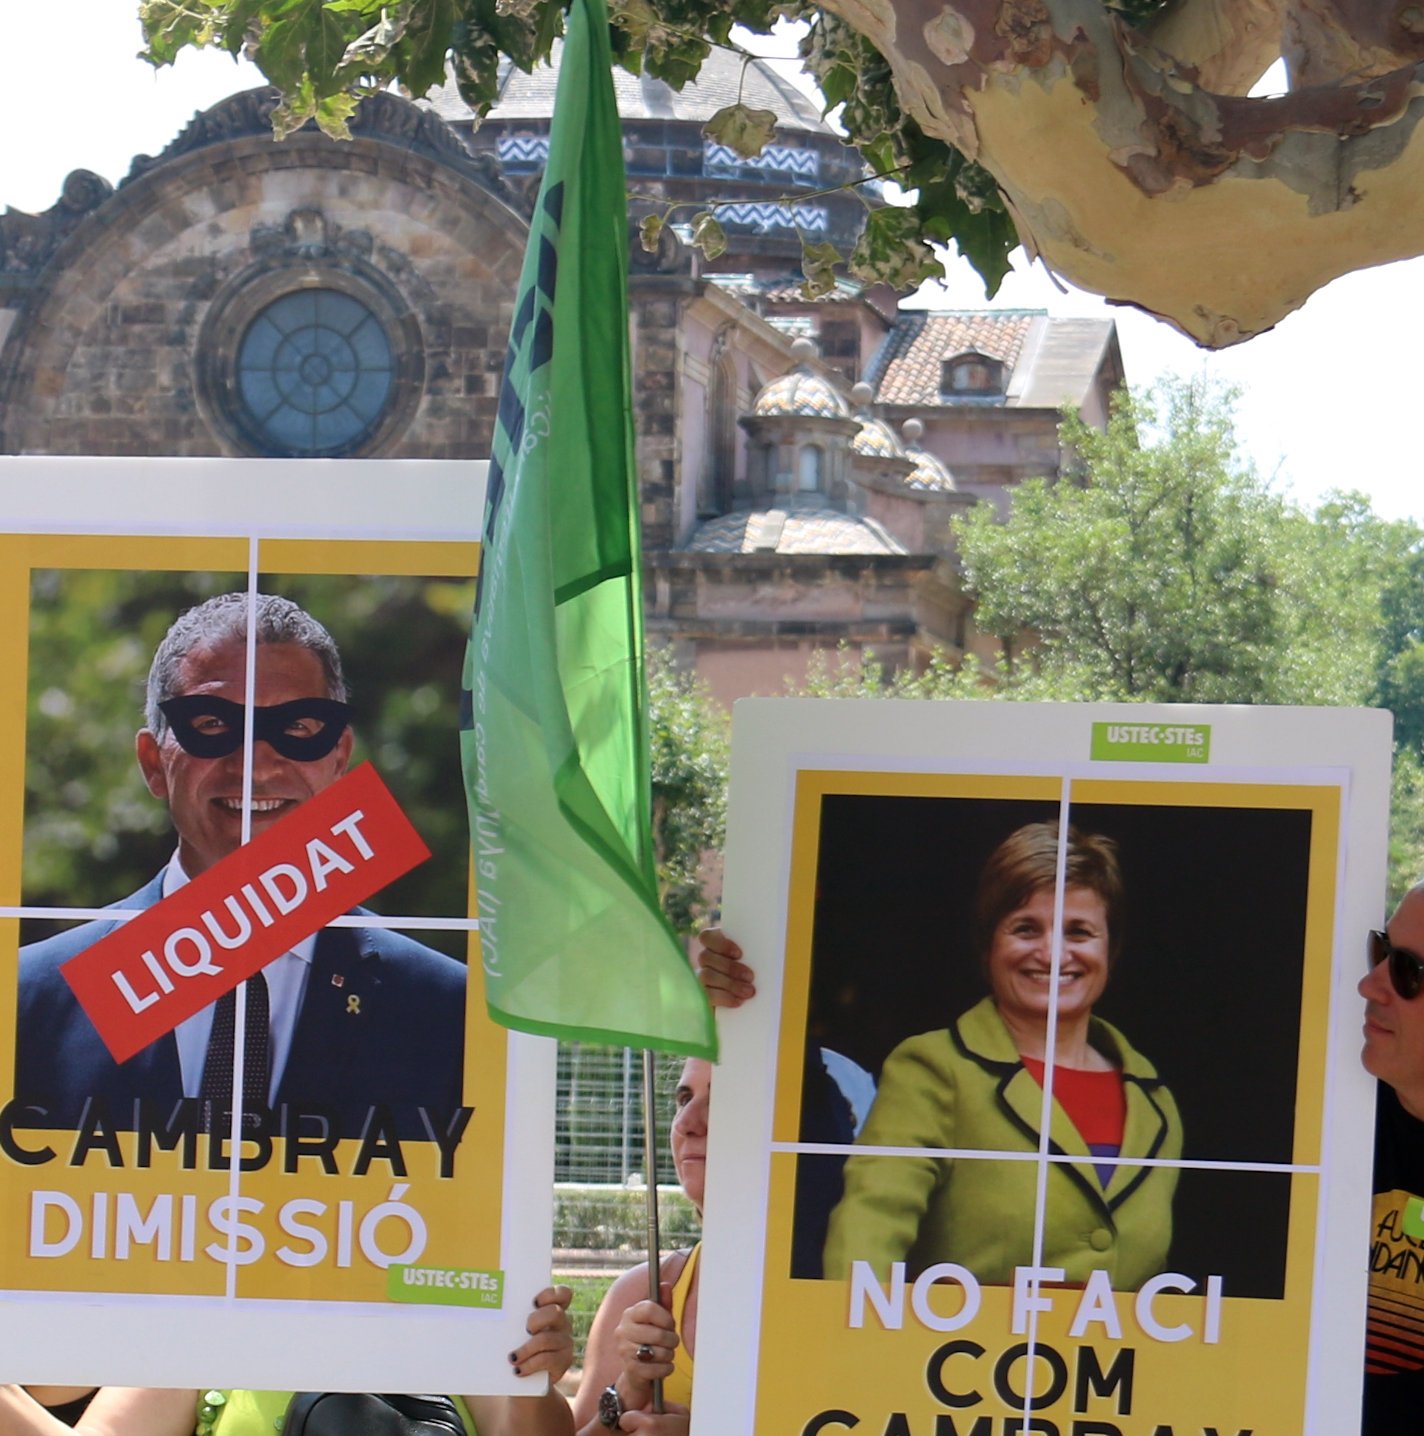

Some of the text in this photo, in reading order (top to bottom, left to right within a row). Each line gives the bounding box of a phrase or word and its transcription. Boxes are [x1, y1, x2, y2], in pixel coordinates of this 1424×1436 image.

[1107, 725, 1204, 745] USTEC·STEs
[1187, 748, 1204, 758] IAC
[112, 810, 376, 1015] LIQUIDAT
[29, 1183, 428, 1270] DIMISSIÓ
[403, 1267, 499, 1291] USTEC·STEs
[481, 1292, 498, 1304] IAC
[848, 1260, 1223, 1344] NO FACI
[926, 1339, 1137, 1416] COM
